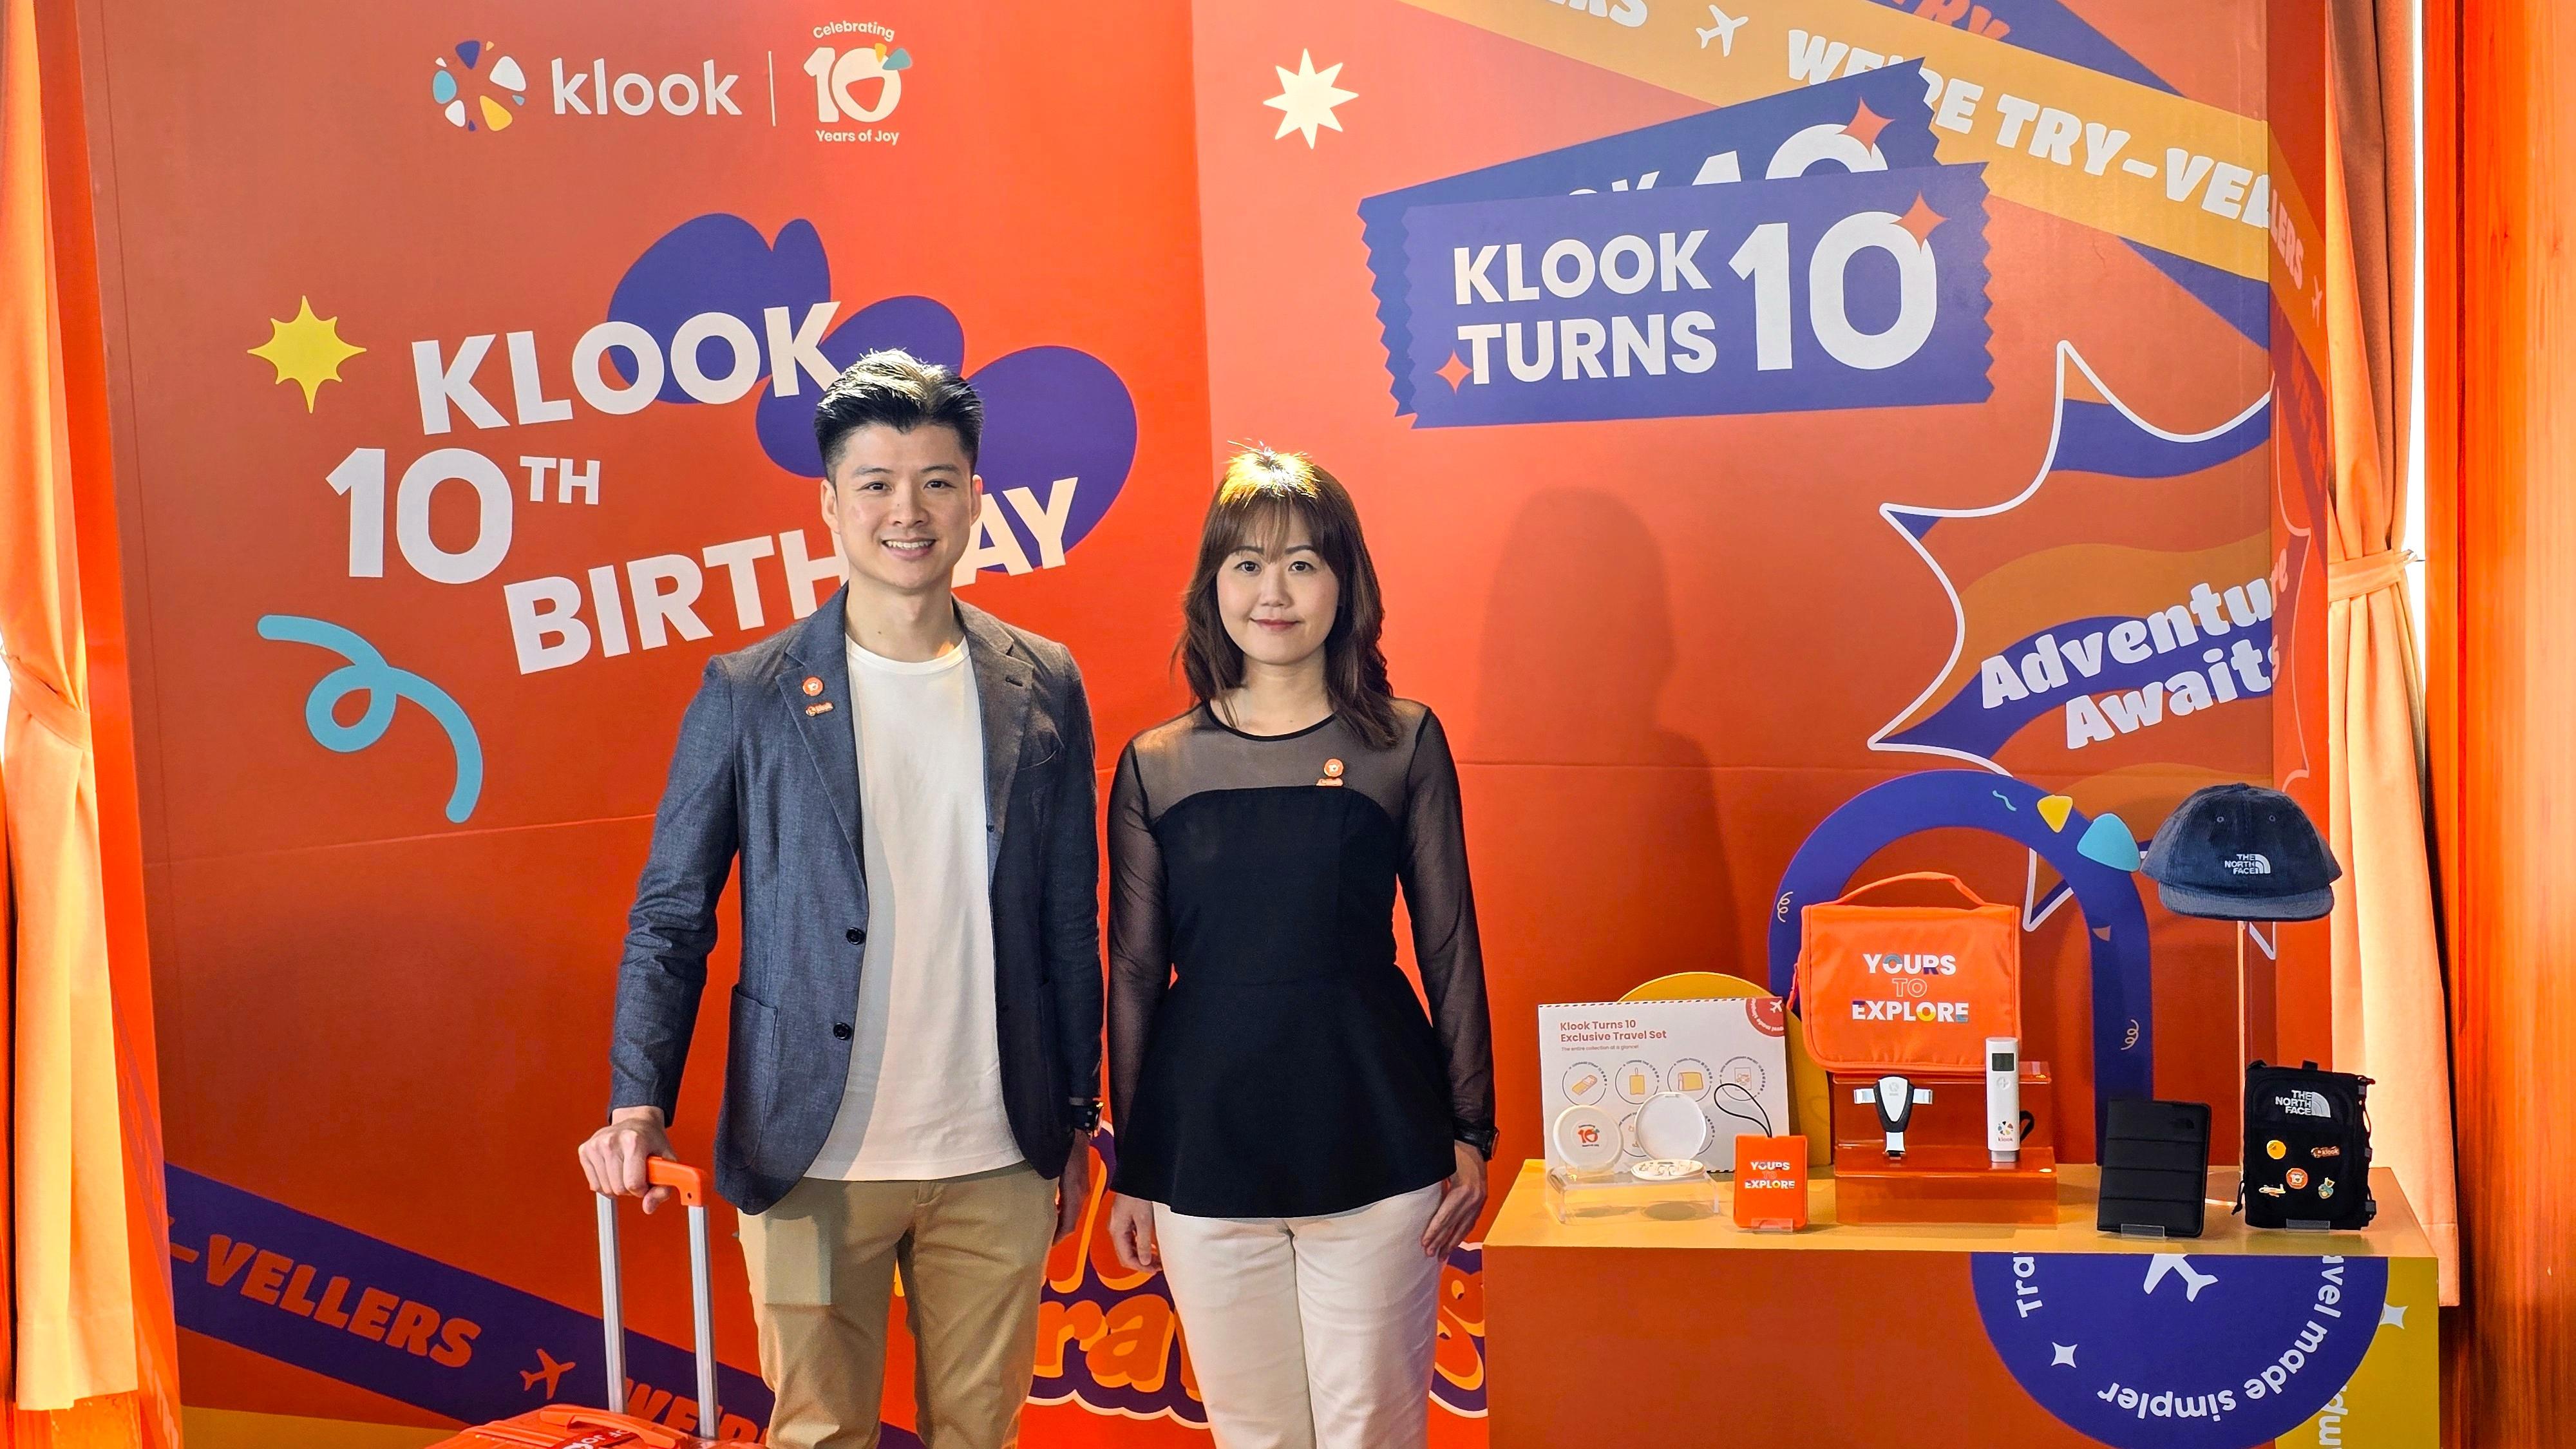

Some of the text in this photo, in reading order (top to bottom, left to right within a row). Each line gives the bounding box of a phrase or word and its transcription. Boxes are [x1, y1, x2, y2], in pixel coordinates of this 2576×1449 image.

[813, 21, 895, 42] Celebrating
[1891, 0, 2011, 40] RY
[551, 57, 743, 116] klook
[804, 47, 902, 123] 10
[815, 129, 900, 146] Years of Joy
[1453, 229, 1712, 305] KLOOK
[1728, 211, 1937, 372] 10
[1457, 310, 1716, 385] TURNS
[411, 301, 845, 435] KLOOK
[504, 477, 1079, 675] BIRTHAY
[1980, 549, 2287, 709] Adventure
[2066, 634, 2280, 749] Awaits
[1862, 953, 1956, 975] YOURS
[1892, 978, 1927, 998] TO
[1560, 1019, 1636, 1031] Klook Turns 10
[1852, 1000, 1969, 1023] EXPLORE
[1561, 1030, 1667, 1042] Exclusive Travel Set
[2275, 1096, 2312, 1108] NORTH
[2285, 1106, 2312, 1115] FACE
[2291, 1090, 2312, 1100] THE
[1745, 1180, 1795, 1189] EXPLORE
[1750, 1161, 1790, 1171] YOURS
[1761, 1171, 1777, 1180] TO
[168, 1216, 481, 1367] -VELLERS
[2013, 1252, 2043, 1318] Tra
[2244, 1320, 2328, 1399] made
[2097, 1382, 2237, 1422] simpler
